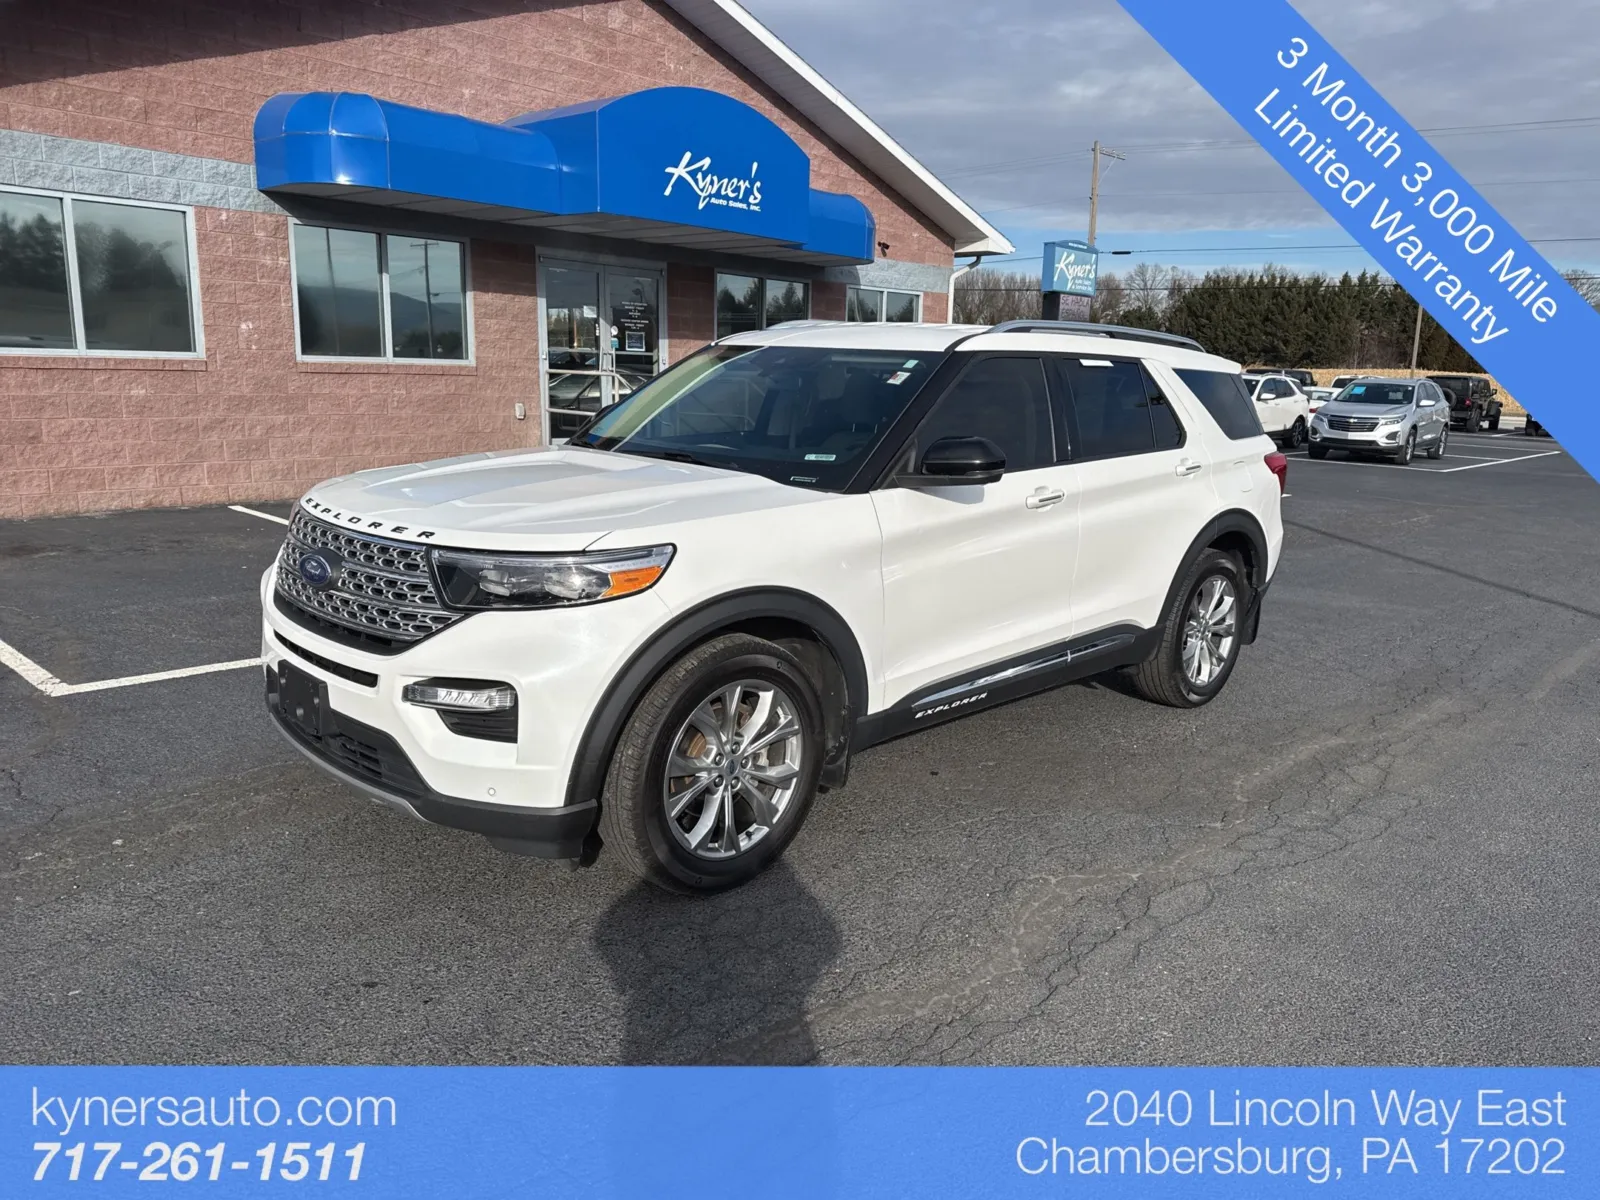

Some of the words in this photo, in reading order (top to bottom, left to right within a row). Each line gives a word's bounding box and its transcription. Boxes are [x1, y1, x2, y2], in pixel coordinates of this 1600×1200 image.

[664, 151, 762, 210] Kyner's
[710, 197, 727, 206] Auto
[1054, 252, 1096, 290] Kyner's
[305, 497, 436, 540] EXPLORER
[914, 692, 988, 719] EXPLORER
